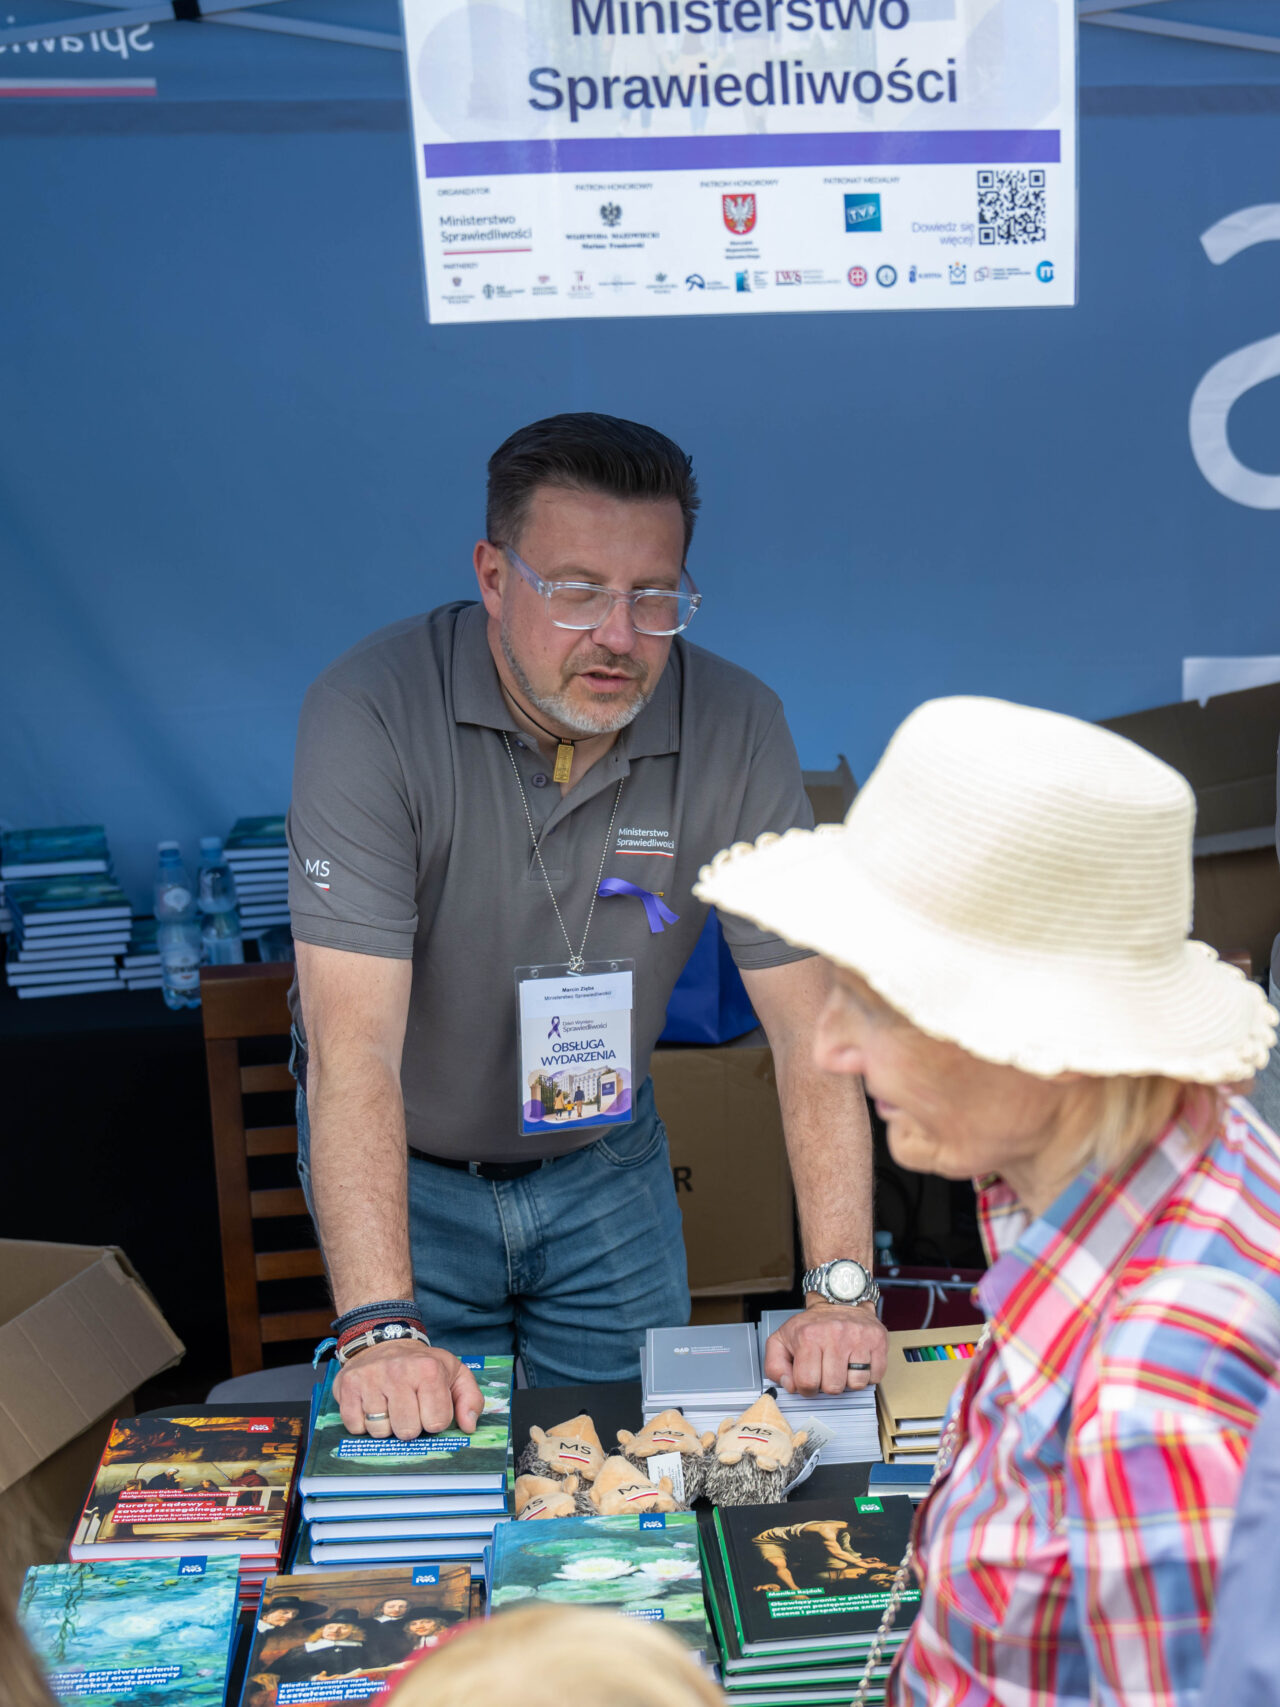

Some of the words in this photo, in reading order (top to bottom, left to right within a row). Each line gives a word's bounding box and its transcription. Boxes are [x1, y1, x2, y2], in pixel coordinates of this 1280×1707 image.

[571, 0, 910, 36] Ministerstwo
[527, 57, 958, 123] Sprawiedliwości
[437, 187, 491, 197] ORGANIZATOR
[849, 203, 878, 223] TVP
[440, 214, 516, 227] Ministerstwo
[441, 227, 533, 243] Sprawiedliwości
[912, 222, 957, 233] Dowiedz
[961, 222, 975, 235] się
[618, 827, 669, 838] Ministerstwo
[616, 838, 675, 849] Sprawiedliwości
[305, 858, 331, 878] MS
[562, 1022, 608, 1033] Sprawiedliwości
[552, 1038, 605, 1053] OBSŁUGA
[540, 1049, 617, 1067] WYDARZENIA
[741, 1426, 773, 1436] MS
[559, 1442, 592, 1455] MS
[161, 1501, 204, 1509] sądowy
[871, 1596, 918, 1605] grupego
[881, 1590, 919, 1598] podku
[137, 1672, 180, 1681] pomocy
